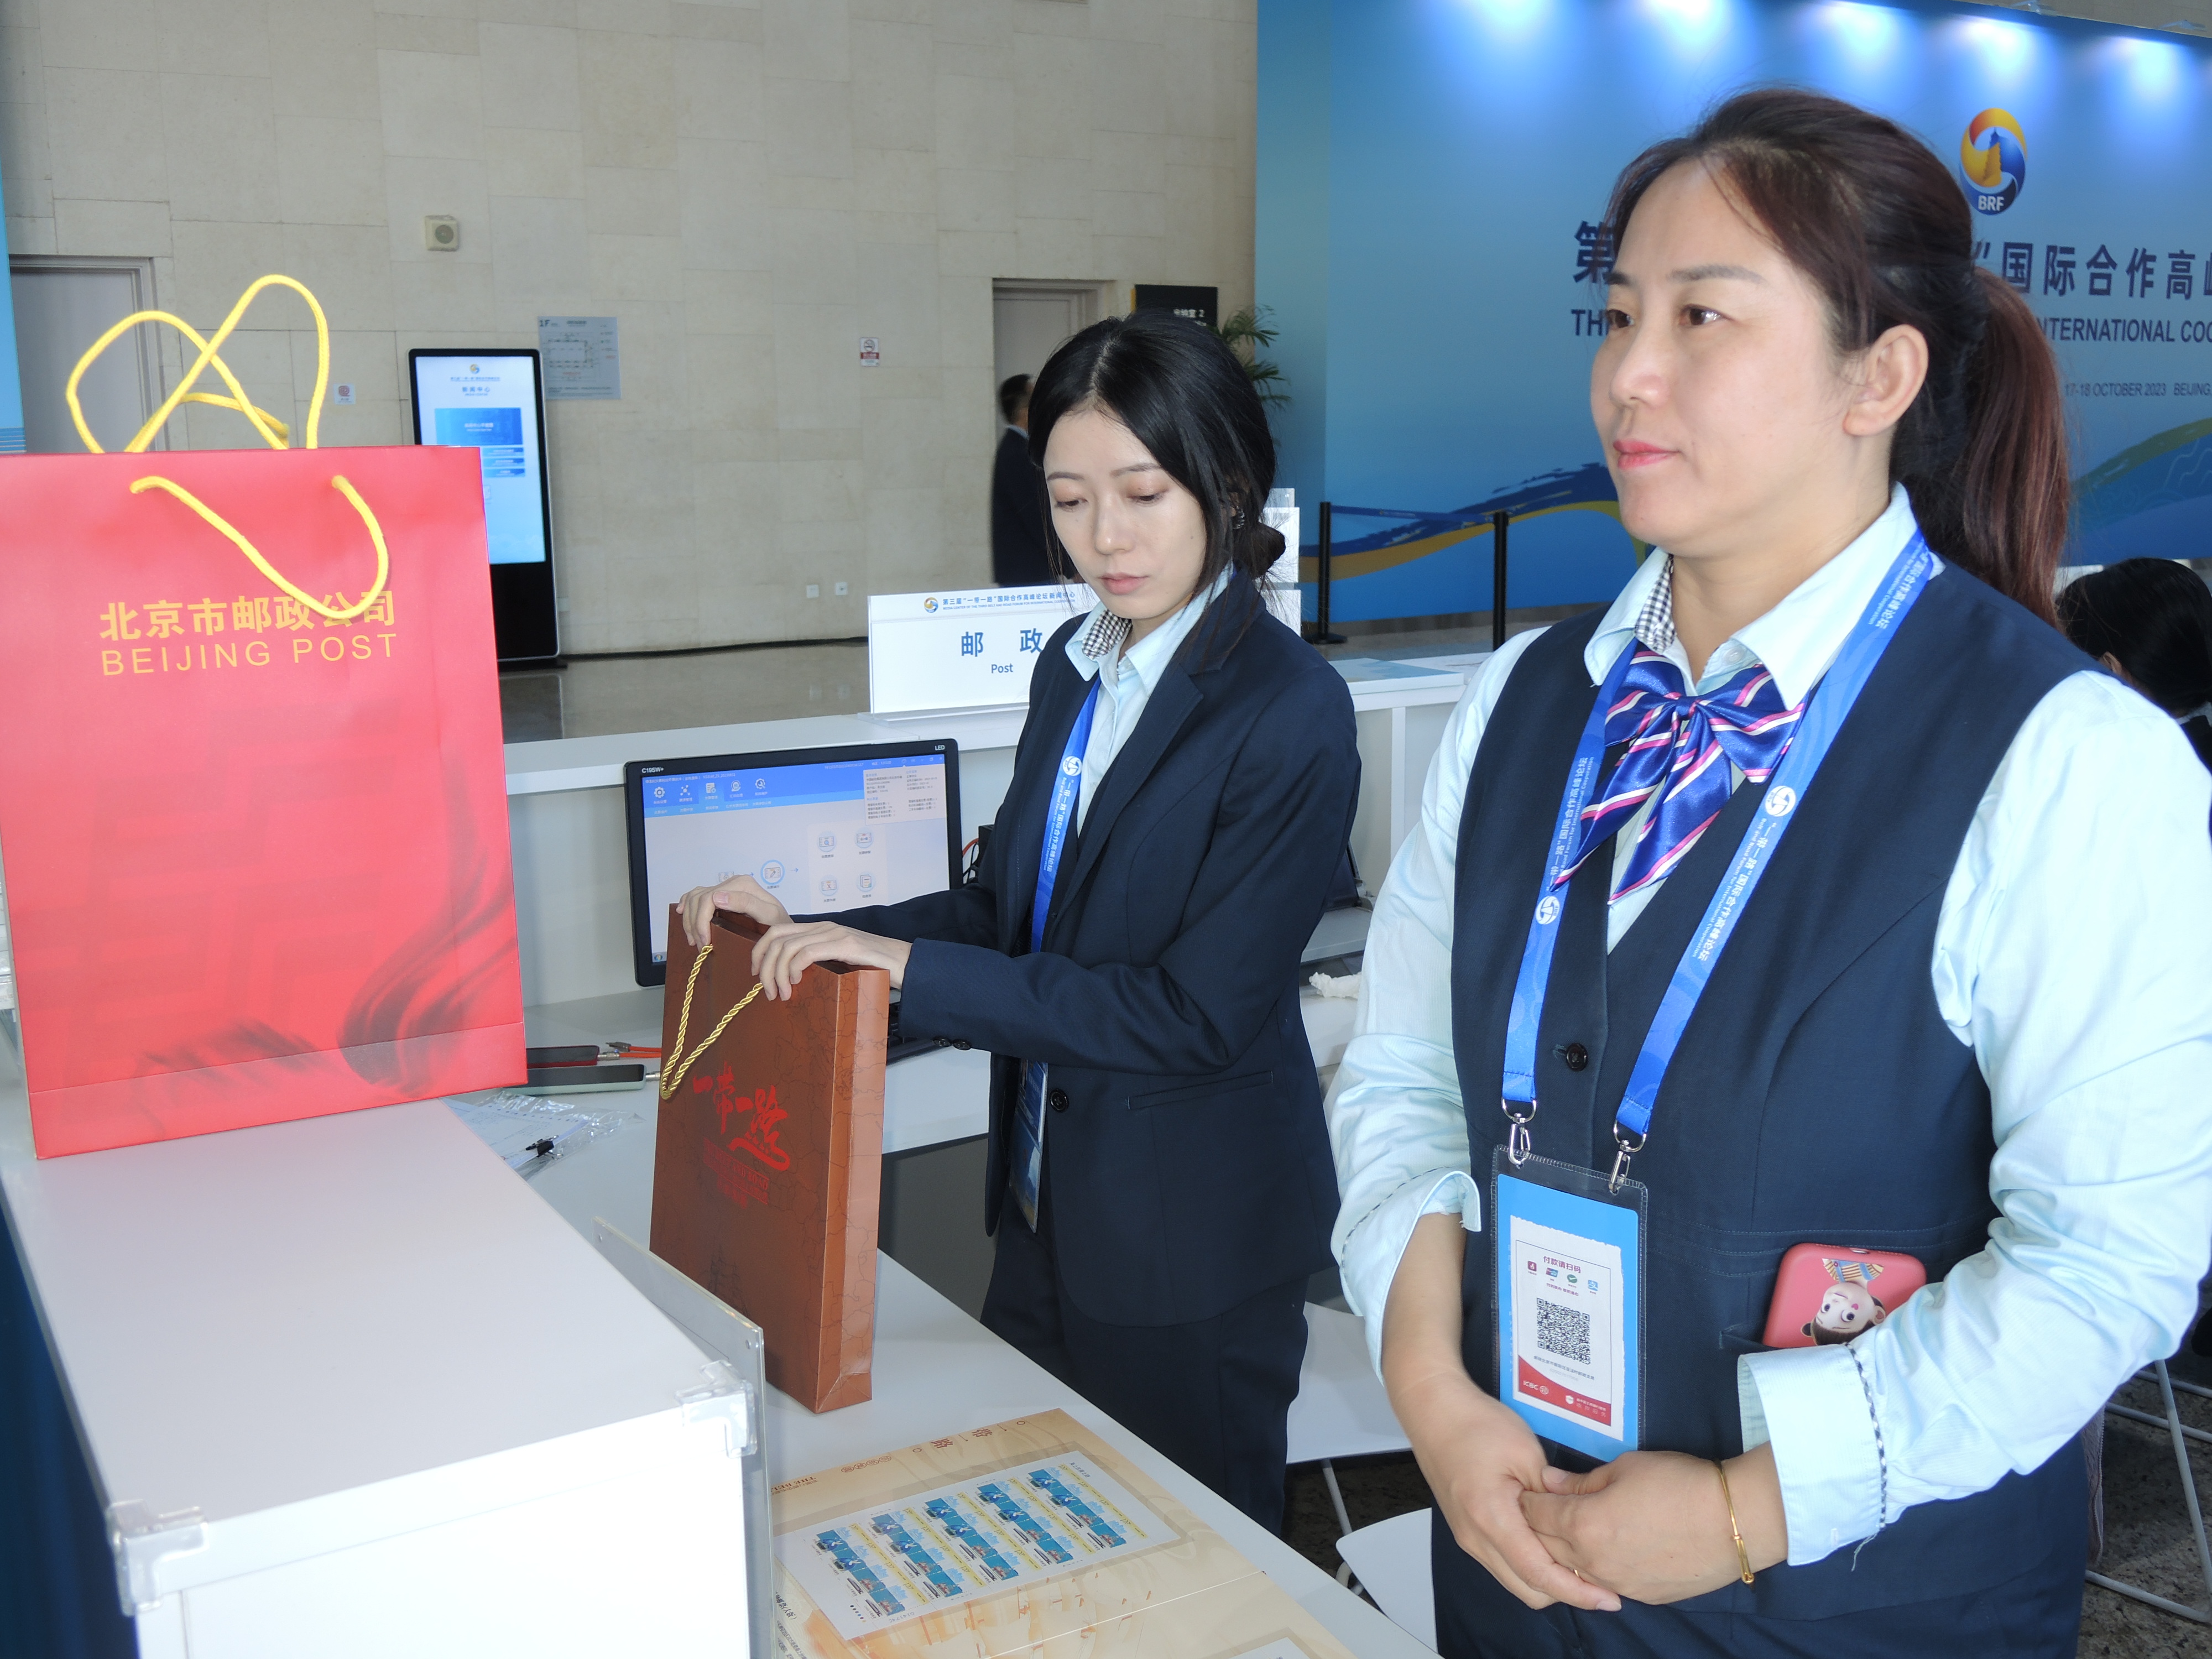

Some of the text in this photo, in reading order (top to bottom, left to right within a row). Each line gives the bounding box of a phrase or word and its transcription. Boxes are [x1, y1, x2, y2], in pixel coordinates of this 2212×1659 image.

[1978, 195, 2004, 211] BRF
[1571, 309, 1610, 336] TH
[2093, 383, 2142, 397] OCTOBER
[2145, 382, 2167, 397] 2023
[101, 633, 397, 676] BEIJING POST
[991, 663, 1013, 674] Post
[1572, 794, 1584, 826] International
[1580, 757, 1594, 791] Cooperation
[1692, 922, 1713, 957] Cooperation
[1543, 1256, 1582, 1273] 付款请扫码
[1523, 1380, 1539, 1390] ICBC
[794, 1475, 816, 1484] THE
